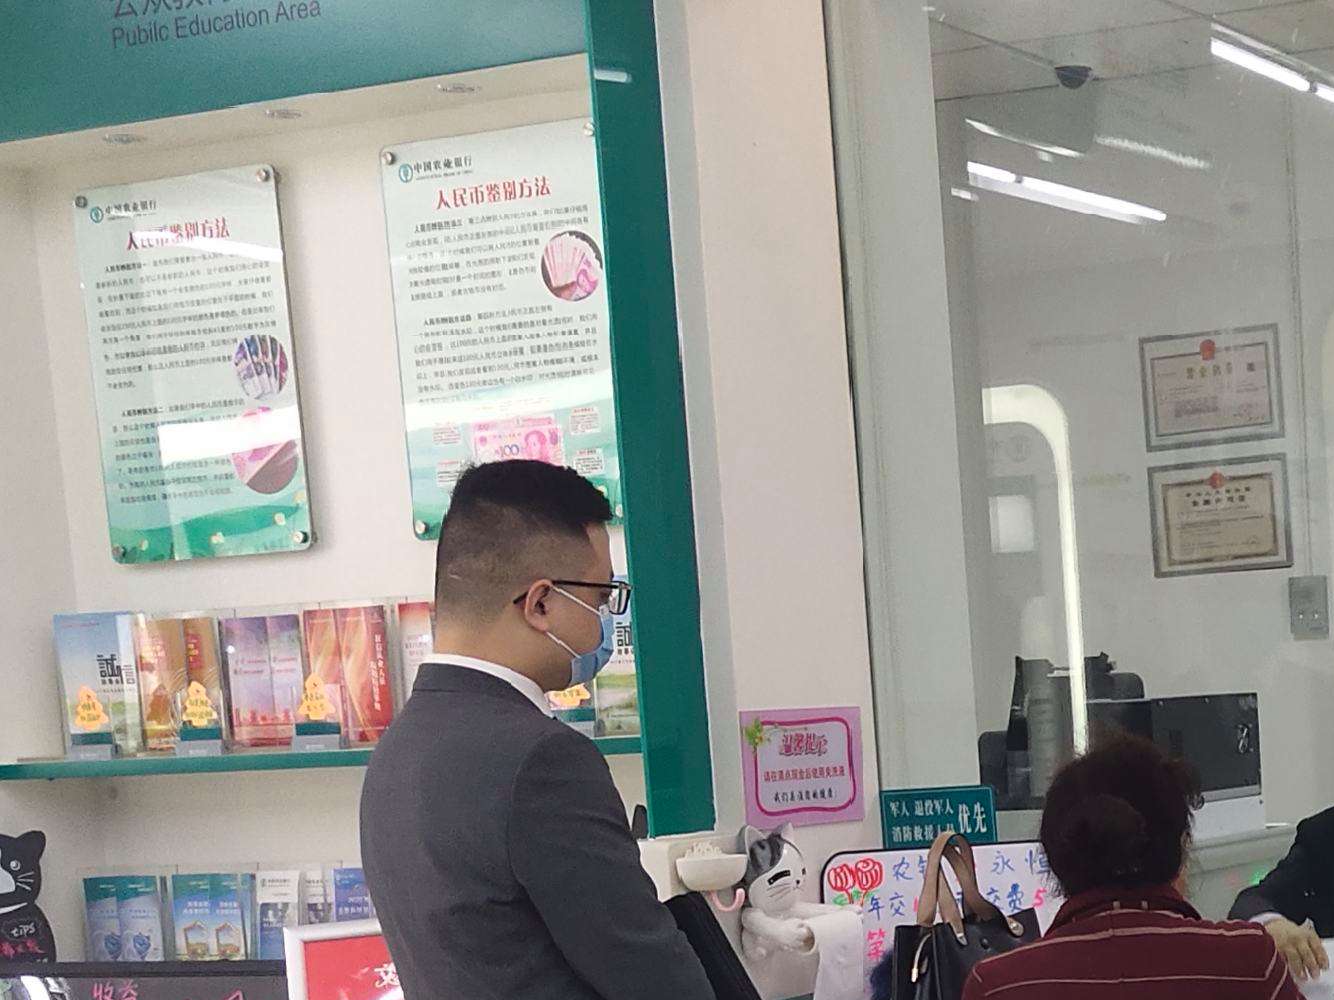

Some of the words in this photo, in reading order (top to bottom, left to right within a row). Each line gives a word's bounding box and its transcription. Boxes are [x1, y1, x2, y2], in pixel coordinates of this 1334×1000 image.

[174, 7, 270, 39] Education
[274, 0, 321, 23] Area
[436, 177, 551, 210] 人民币鉴别方法
[890, 801, 909, 818] 军人
[958, 802, 987, 834] 优先
